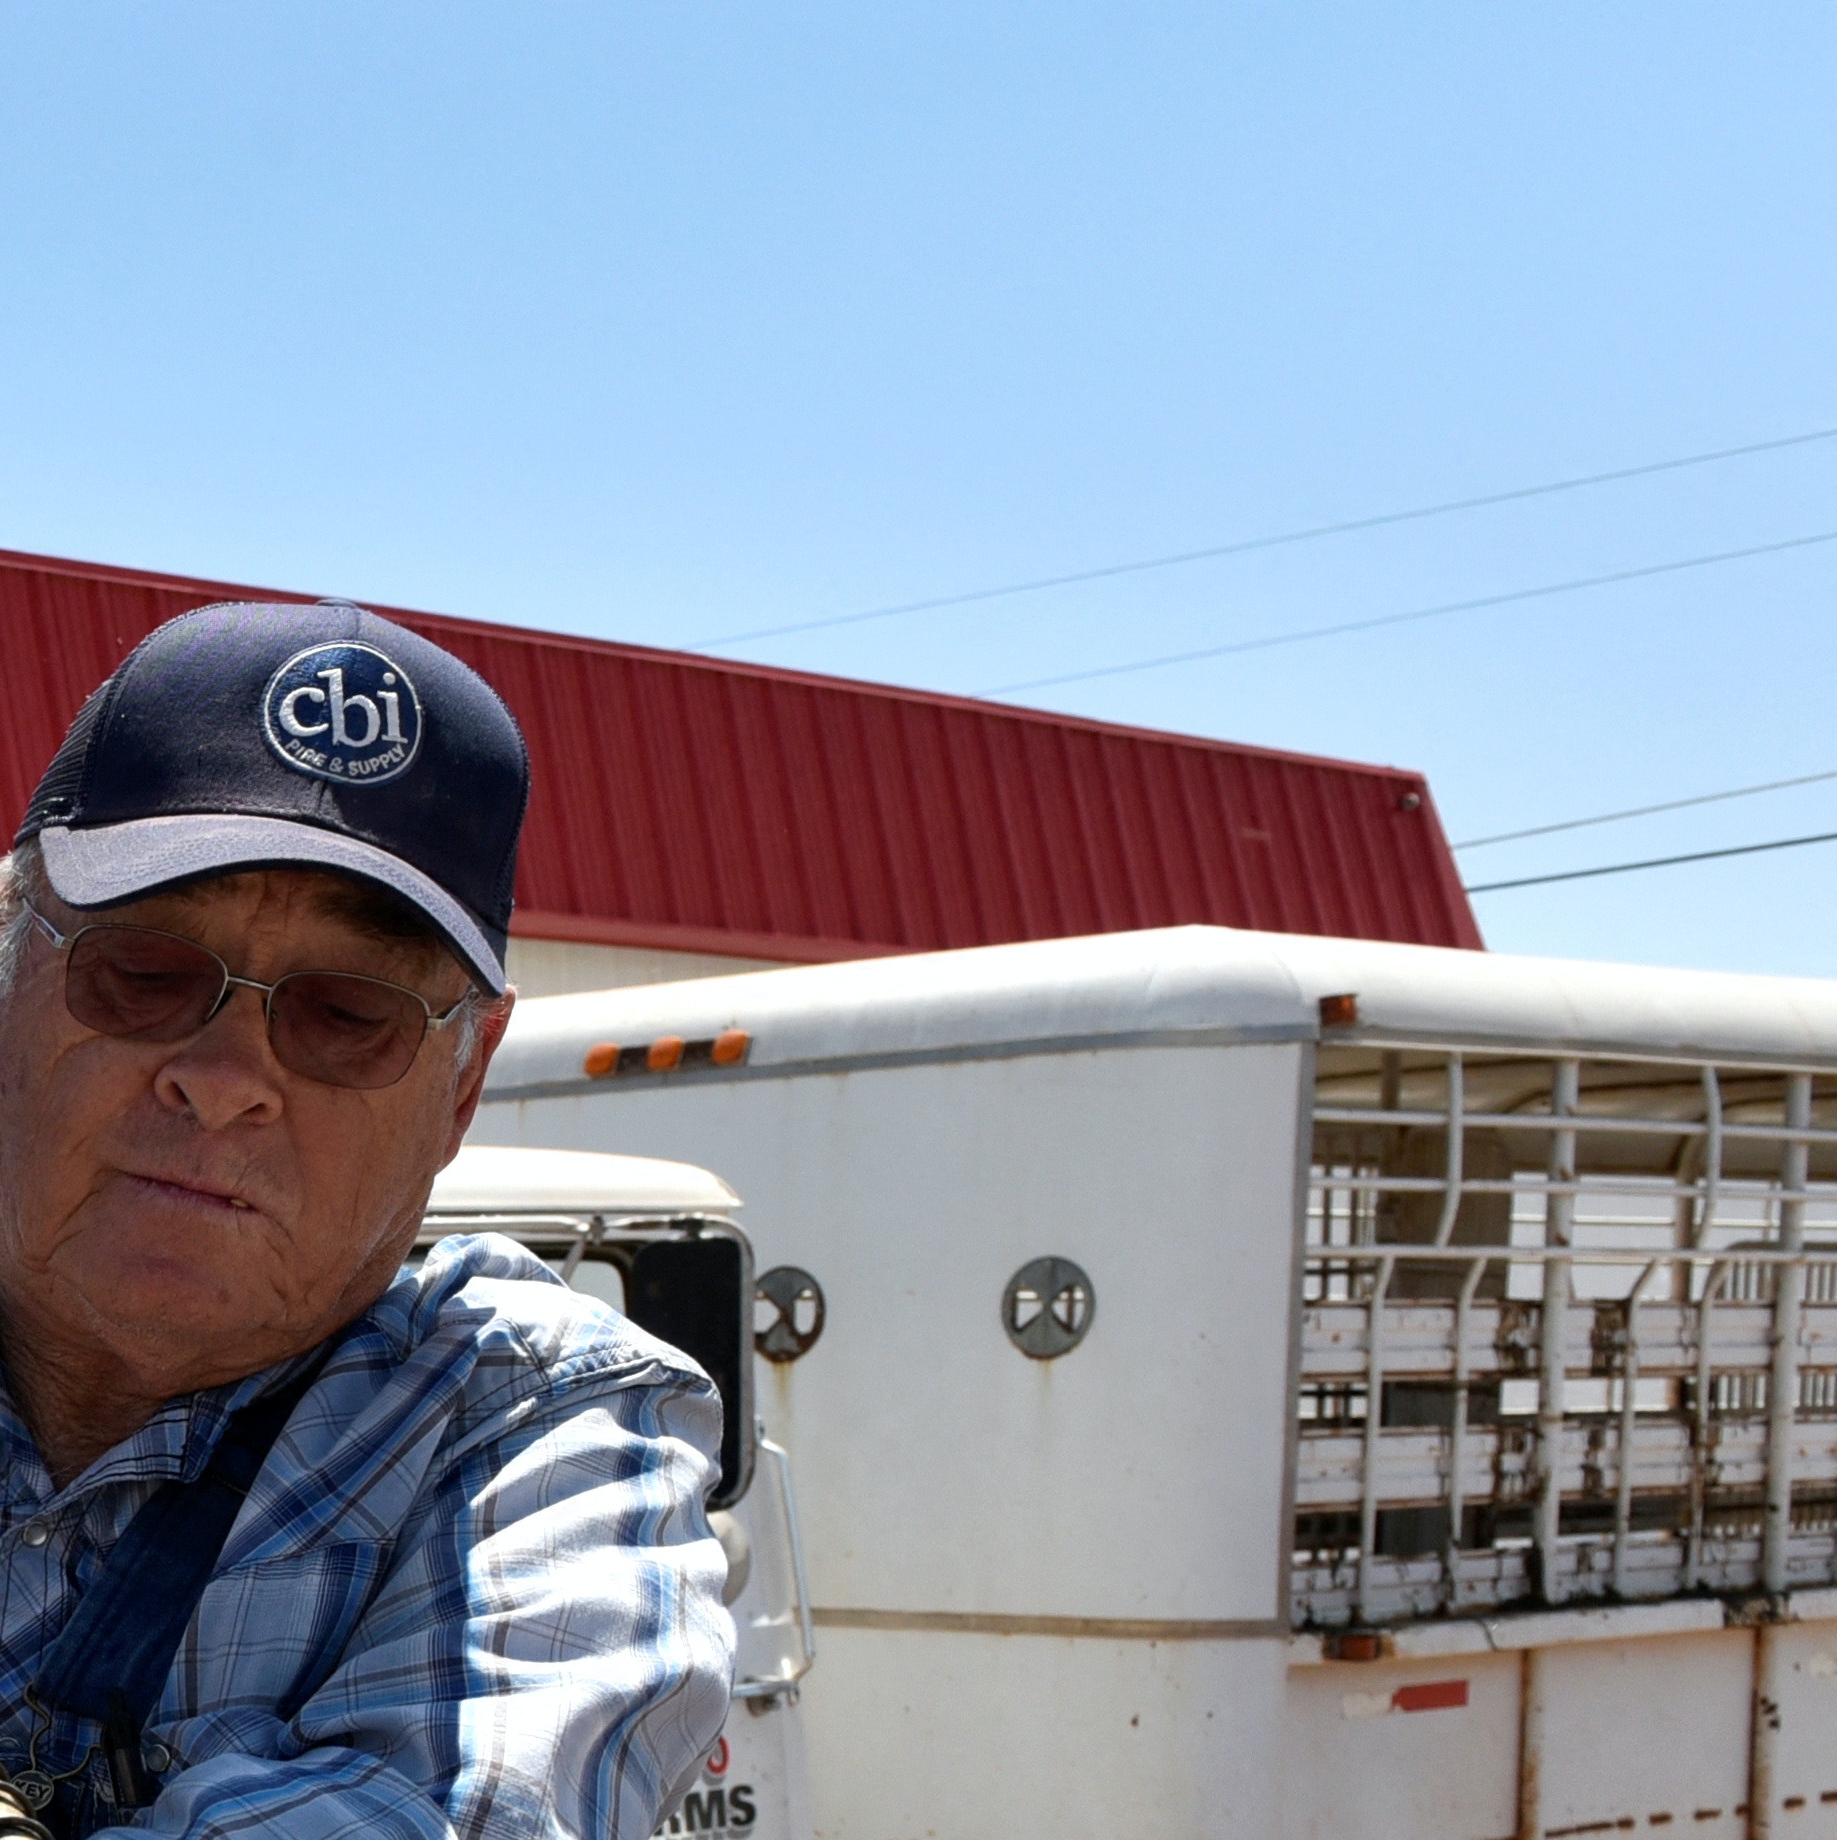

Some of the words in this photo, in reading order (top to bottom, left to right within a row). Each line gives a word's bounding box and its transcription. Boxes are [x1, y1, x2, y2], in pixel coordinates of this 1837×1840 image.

[278, 668, 408, 748] cbi
[328, 757, 345, 773] &
[348, 743, 406, 777] SUPPLY
